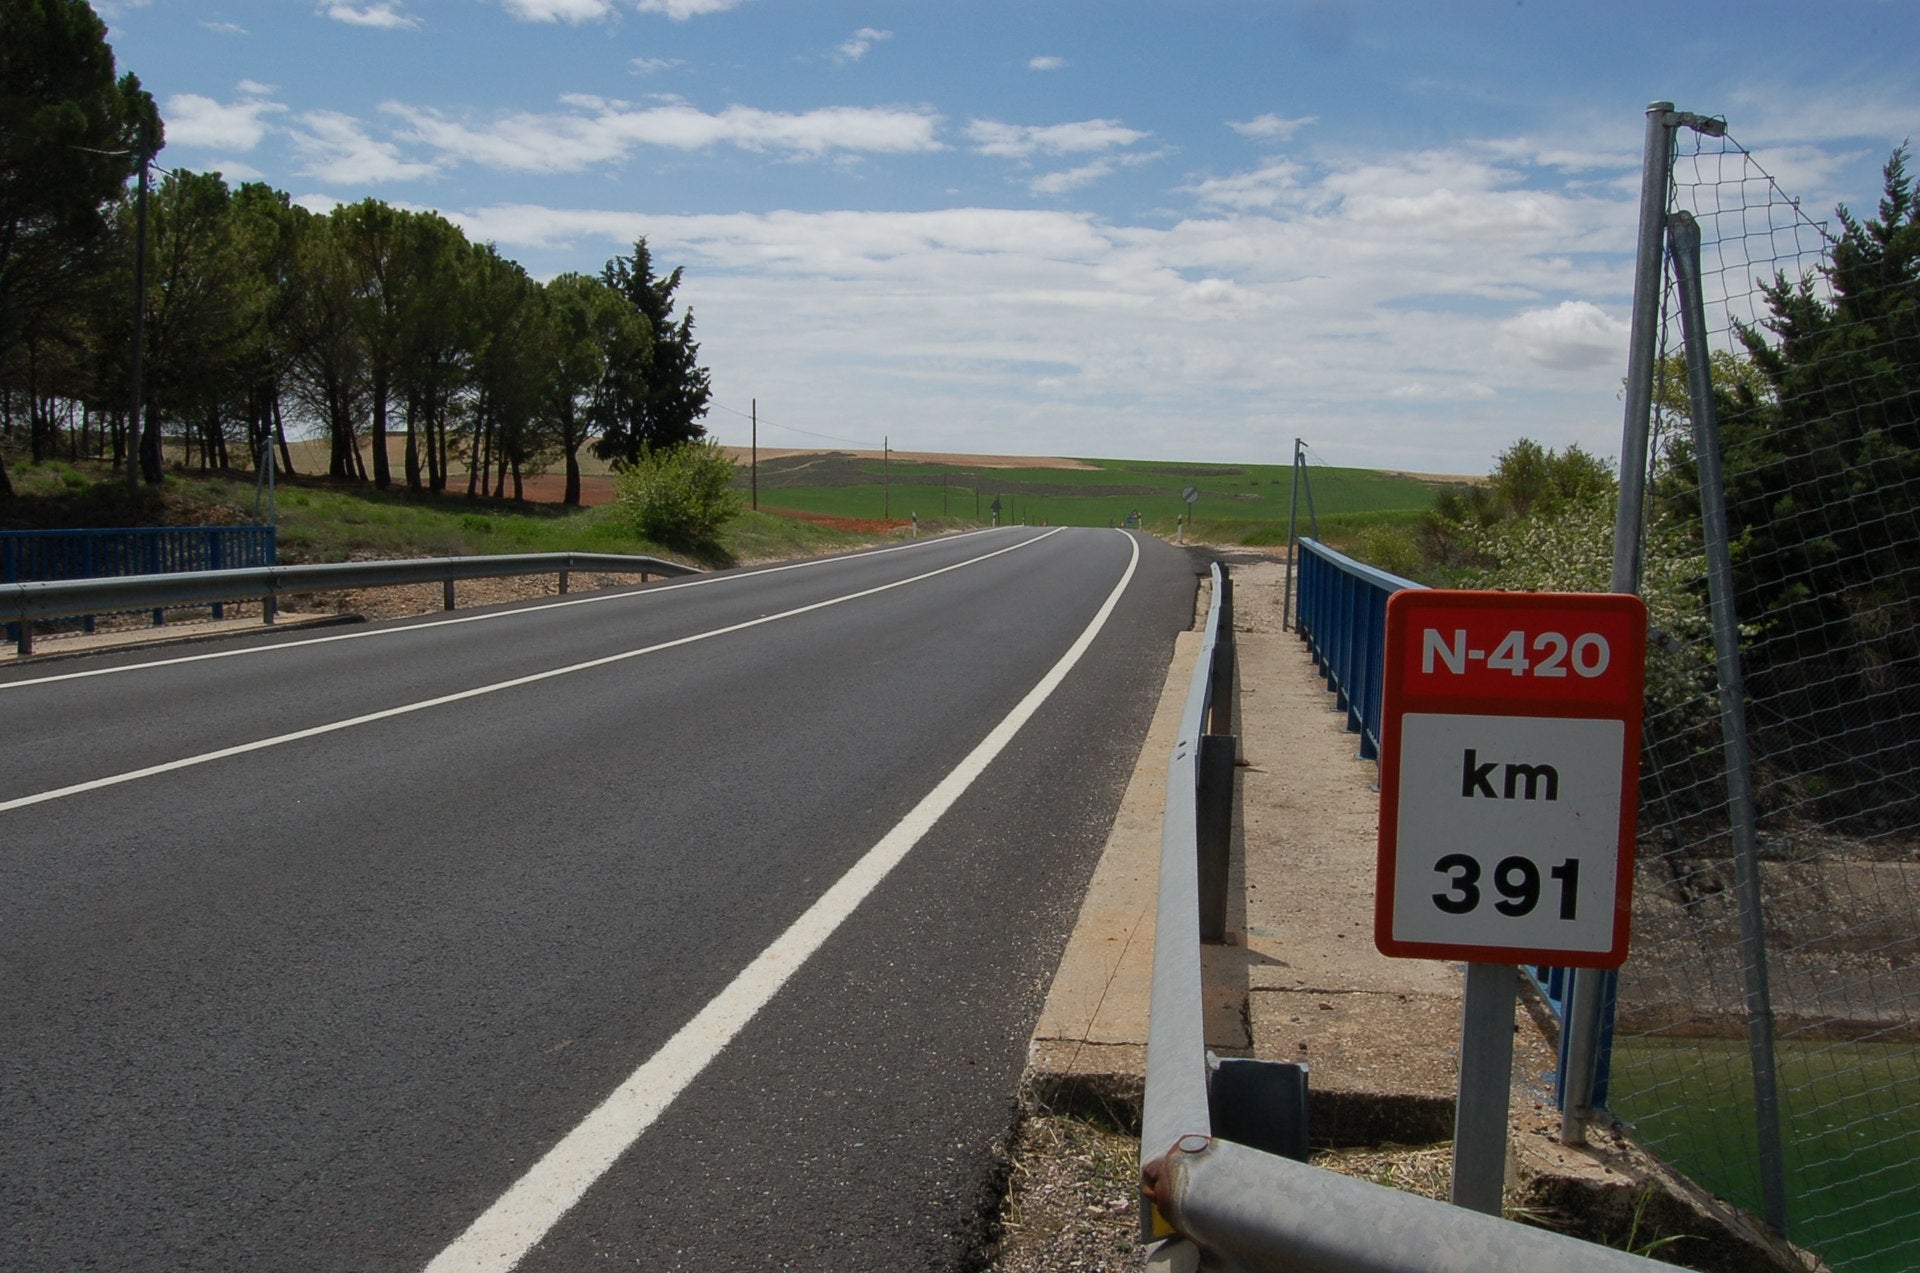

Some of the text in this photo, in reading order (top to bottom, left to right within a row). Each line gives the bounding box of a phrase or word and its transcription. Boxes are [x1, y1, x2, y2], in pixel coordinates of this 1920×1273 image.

[1421, 628, 1611, 678] N-420
[1461, 748, 1559, 801] km
[1431, 853, 1580, 921] 391
